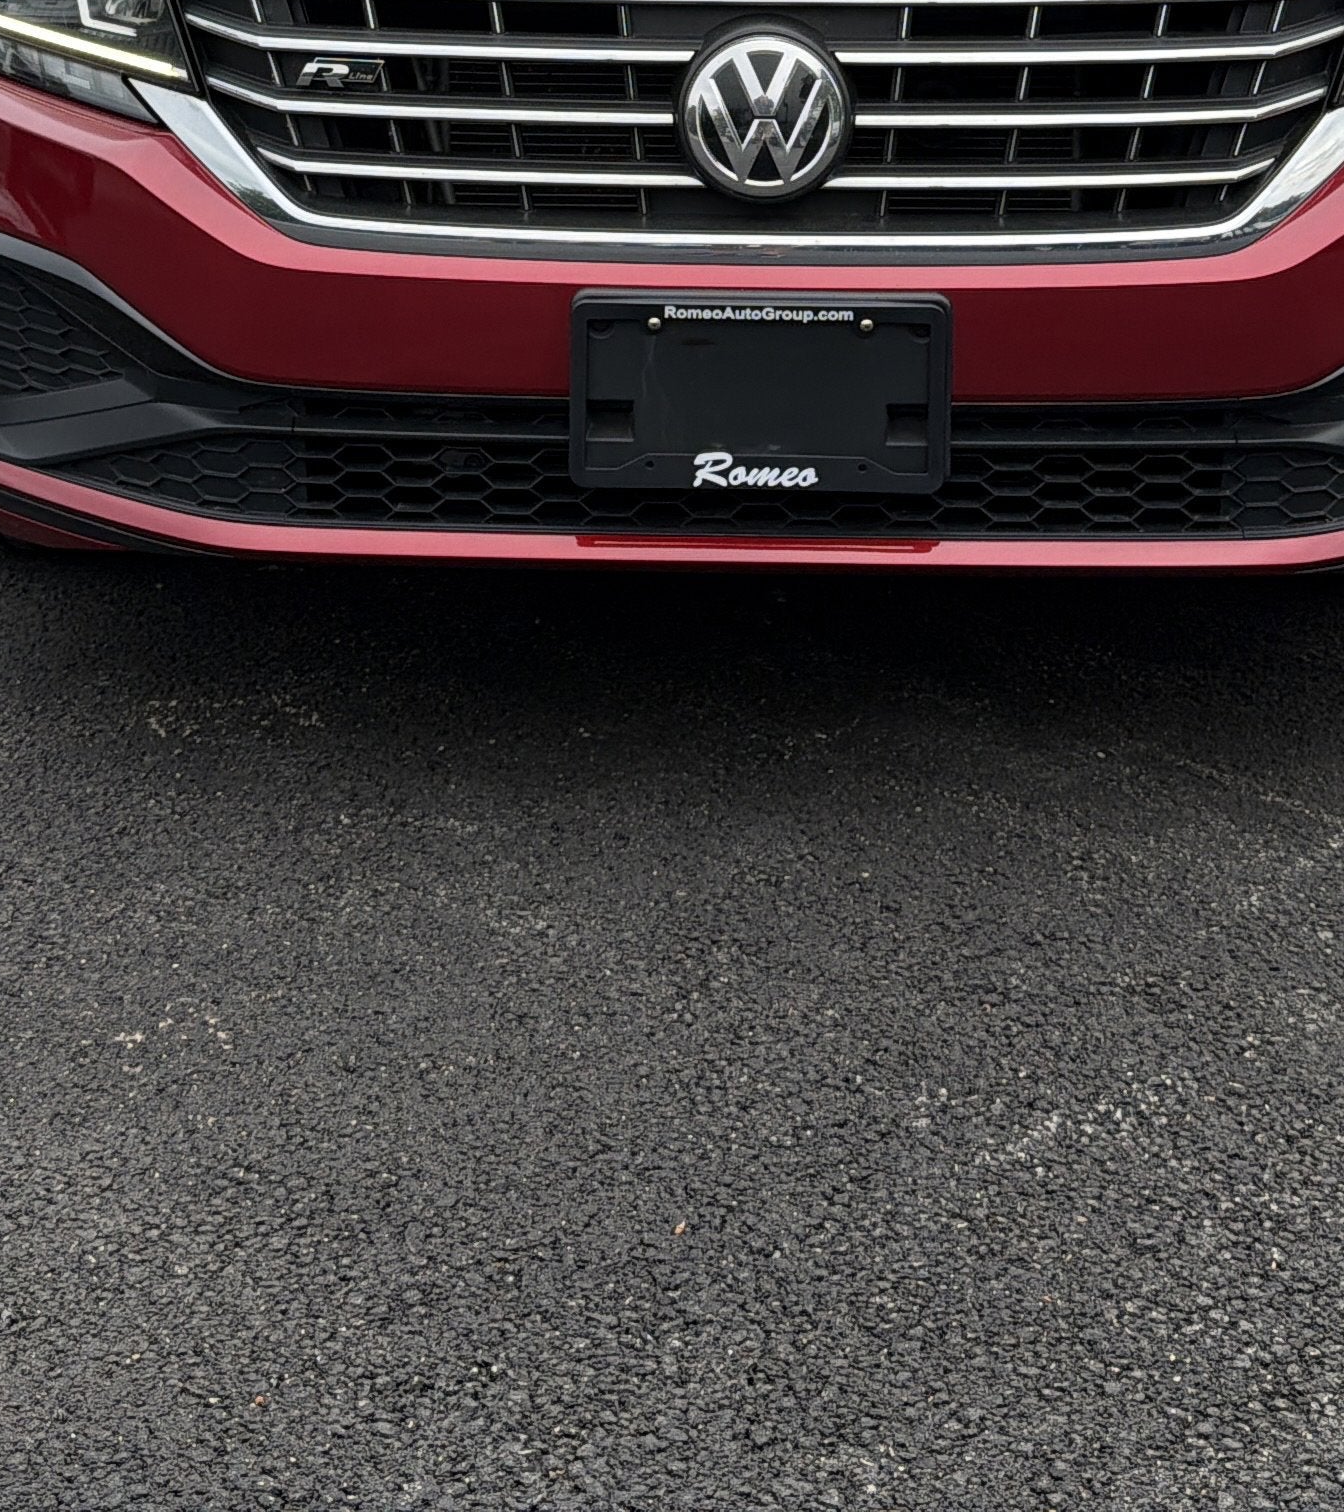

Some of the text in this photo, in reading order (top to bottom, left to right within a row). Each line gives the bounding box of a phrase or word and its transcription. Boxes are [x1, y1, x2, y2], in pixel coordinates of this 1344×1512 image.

[296, 62, 350, 88] R
[663, 305, 854, 323] RomeoAutoGroup.com
[693, 452, 819, 488] Romeo
